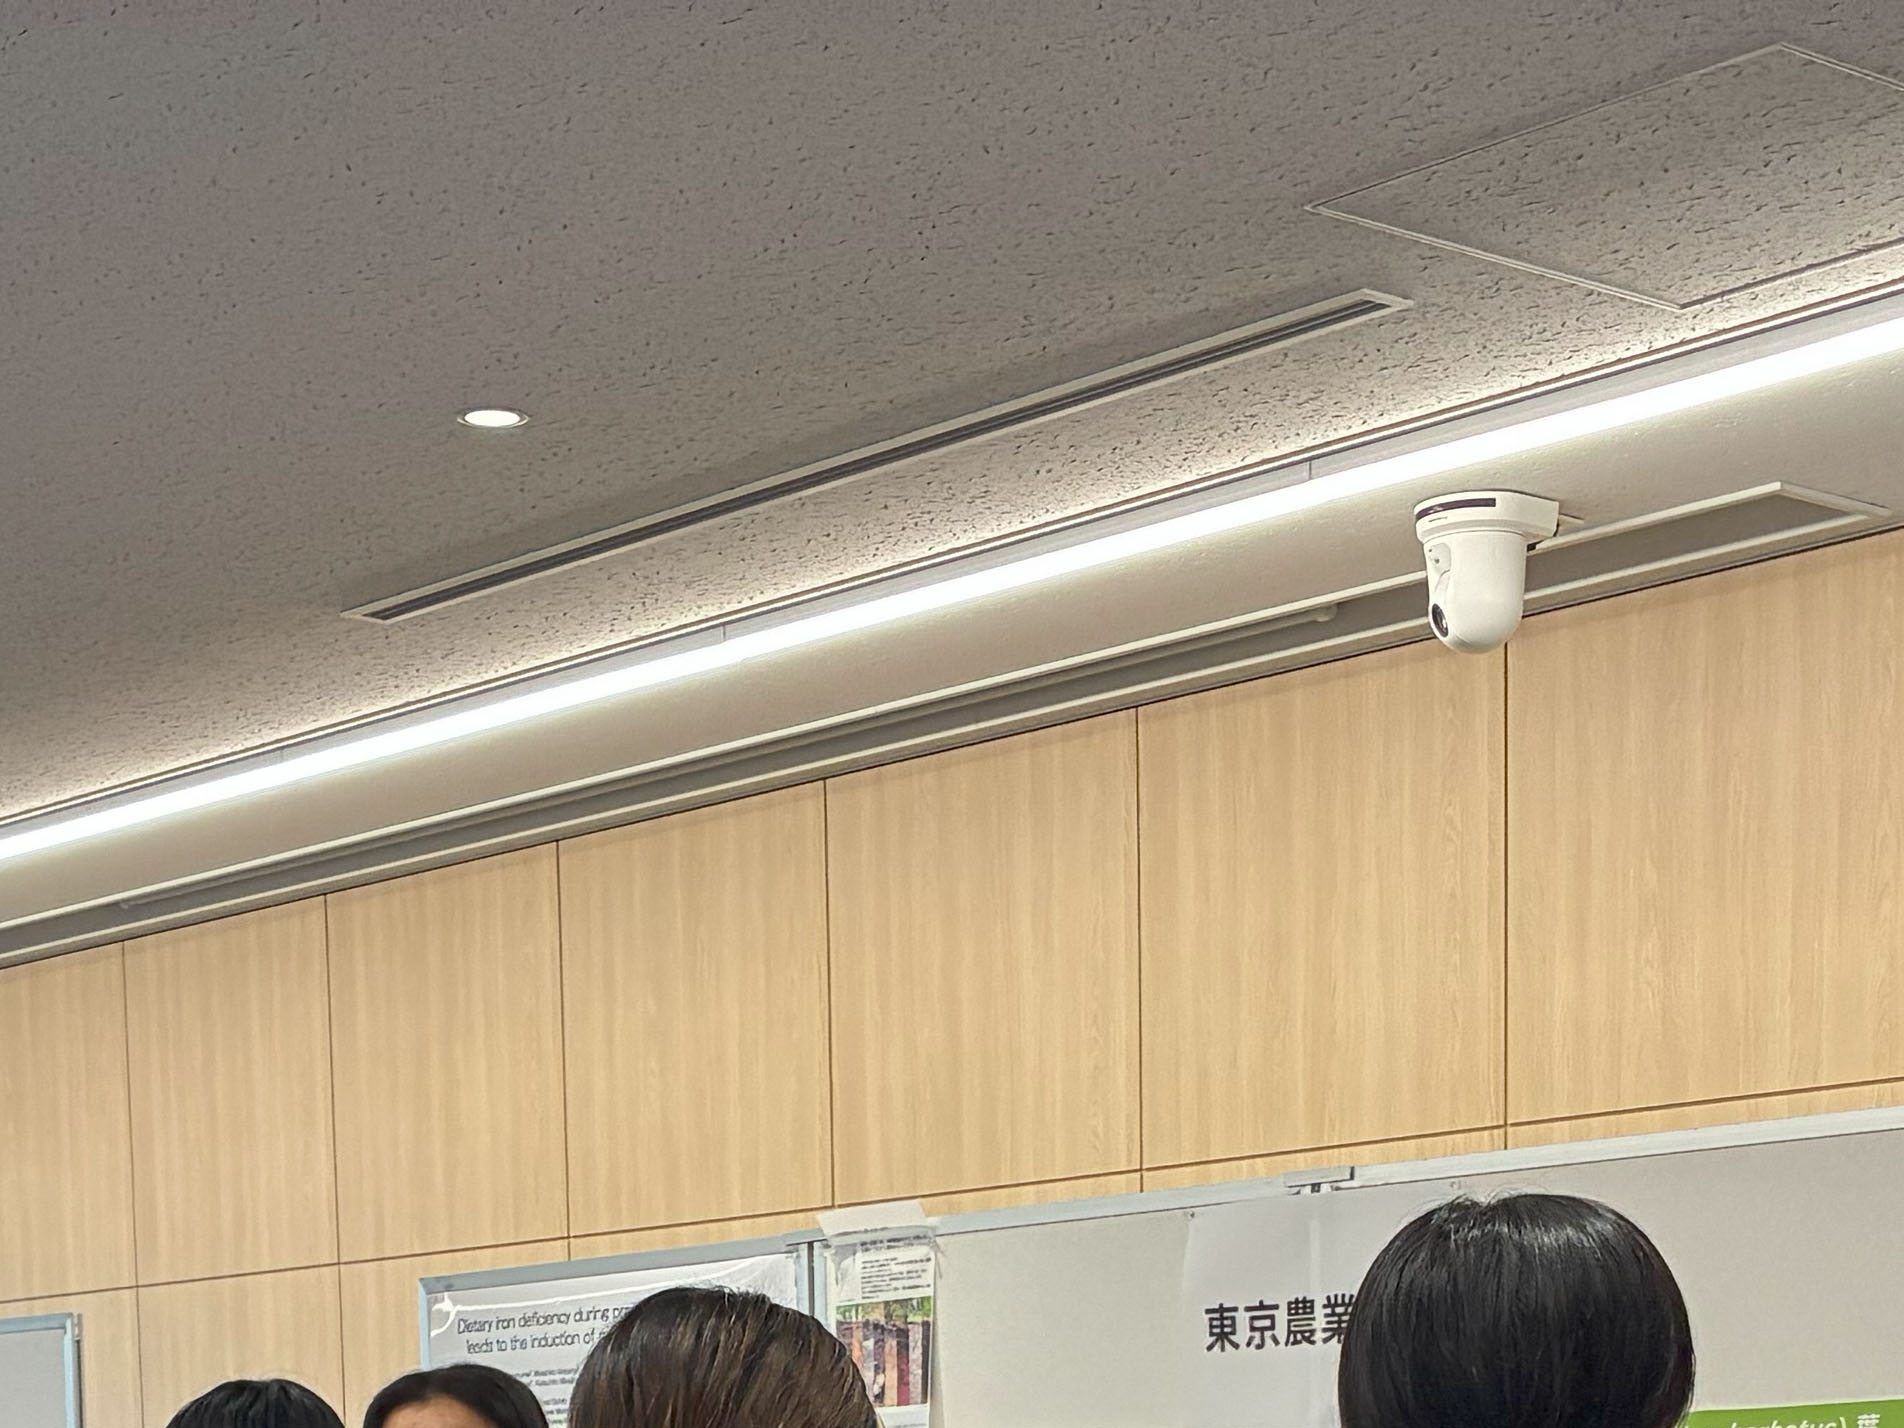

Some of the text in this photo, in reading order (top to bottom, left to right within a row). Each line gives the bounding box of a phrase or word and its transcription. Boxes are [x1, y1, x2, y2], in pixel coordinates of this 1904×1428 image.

[457, 1318, 493, 1335] Dietary
[496, 1316, 516, 1330] iron
[518, 1310, 571, 1329] deficiency
[573, 1306, 610, 1323] during
[1204, 1293, 1356, 1352] 東京農業
[496, 1338, 508, 1352] to
[530, 1331, 581, 1349] induction
